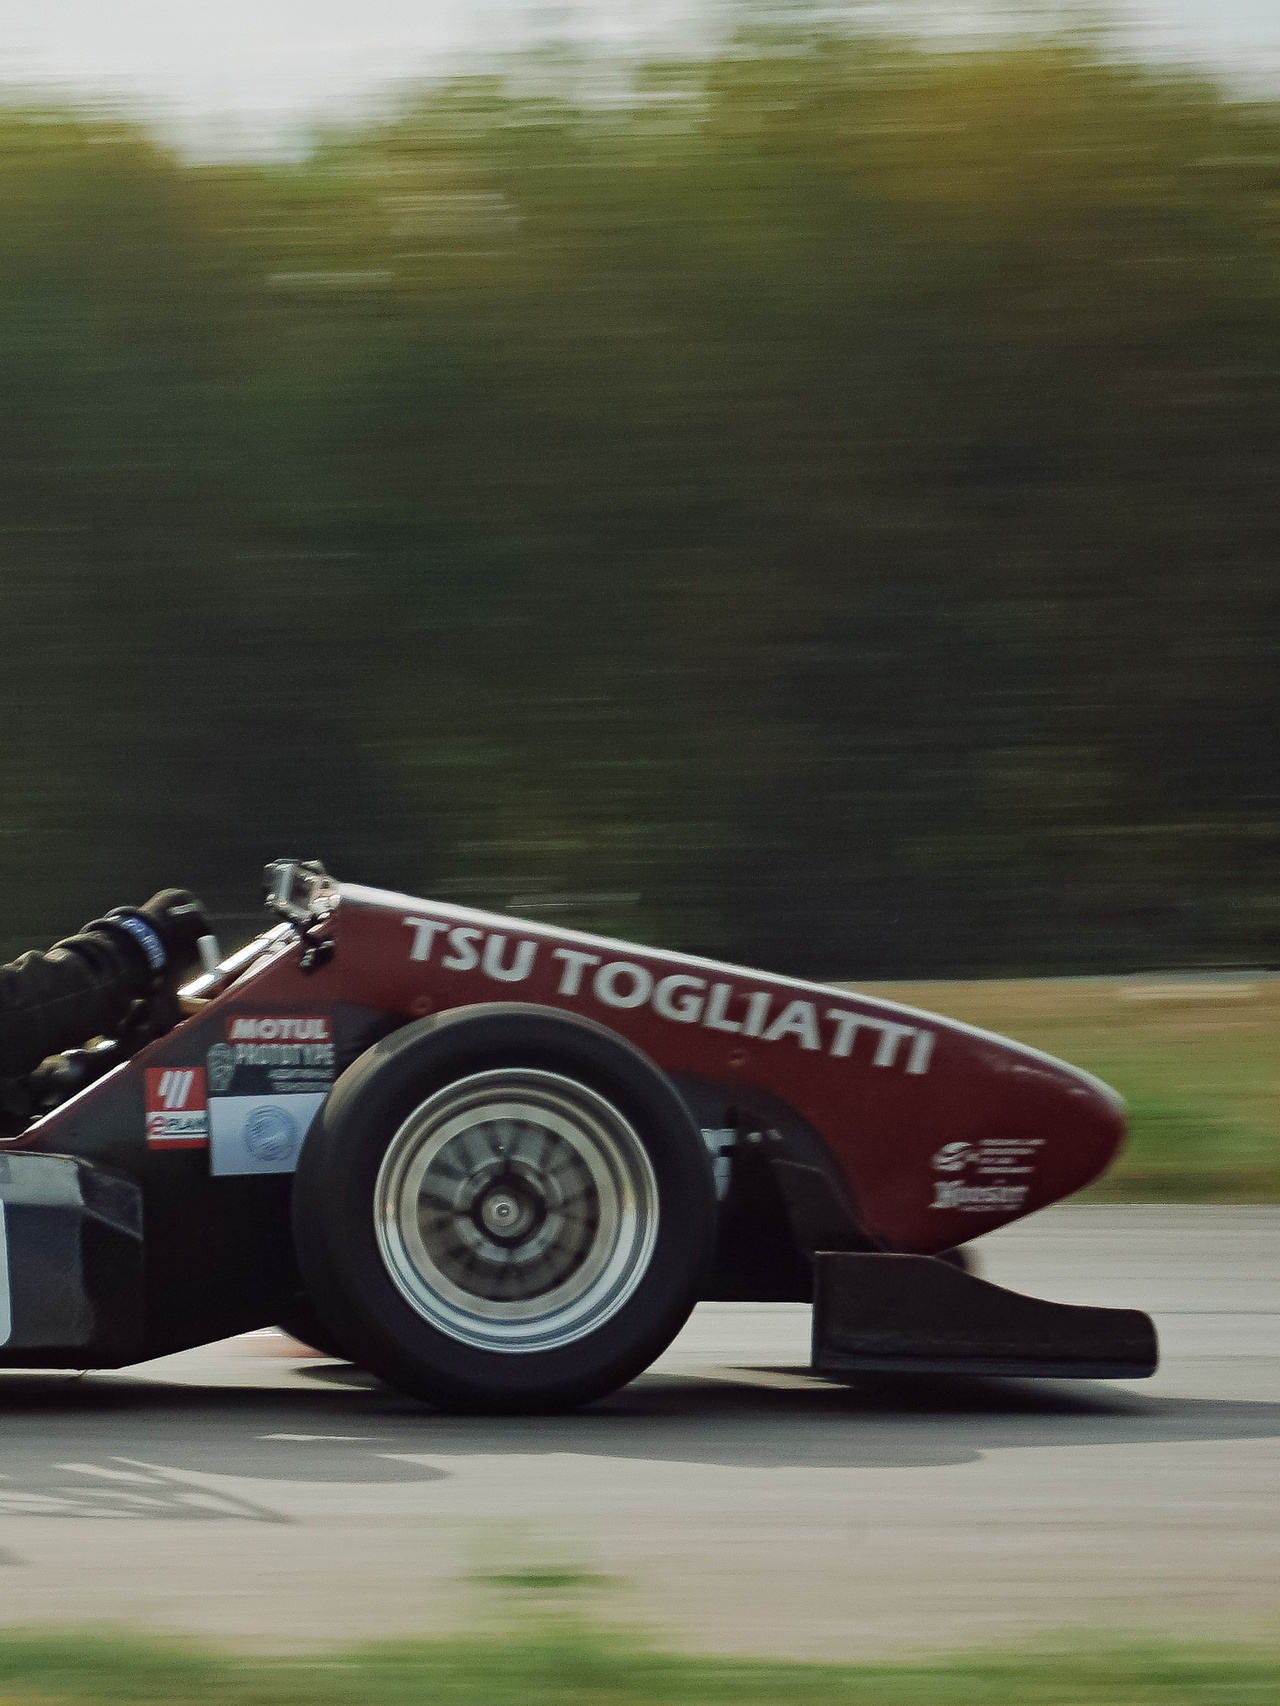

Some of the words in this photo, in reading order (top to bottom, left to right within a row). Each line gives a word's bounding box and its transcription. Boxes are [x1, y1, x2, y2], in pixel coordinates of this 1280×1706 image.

[228, 1018, 329, 1039] MOTUL
[403, 916, 538, 981] TSU
[552, 948, 936, 1075] TOGLIATTI
